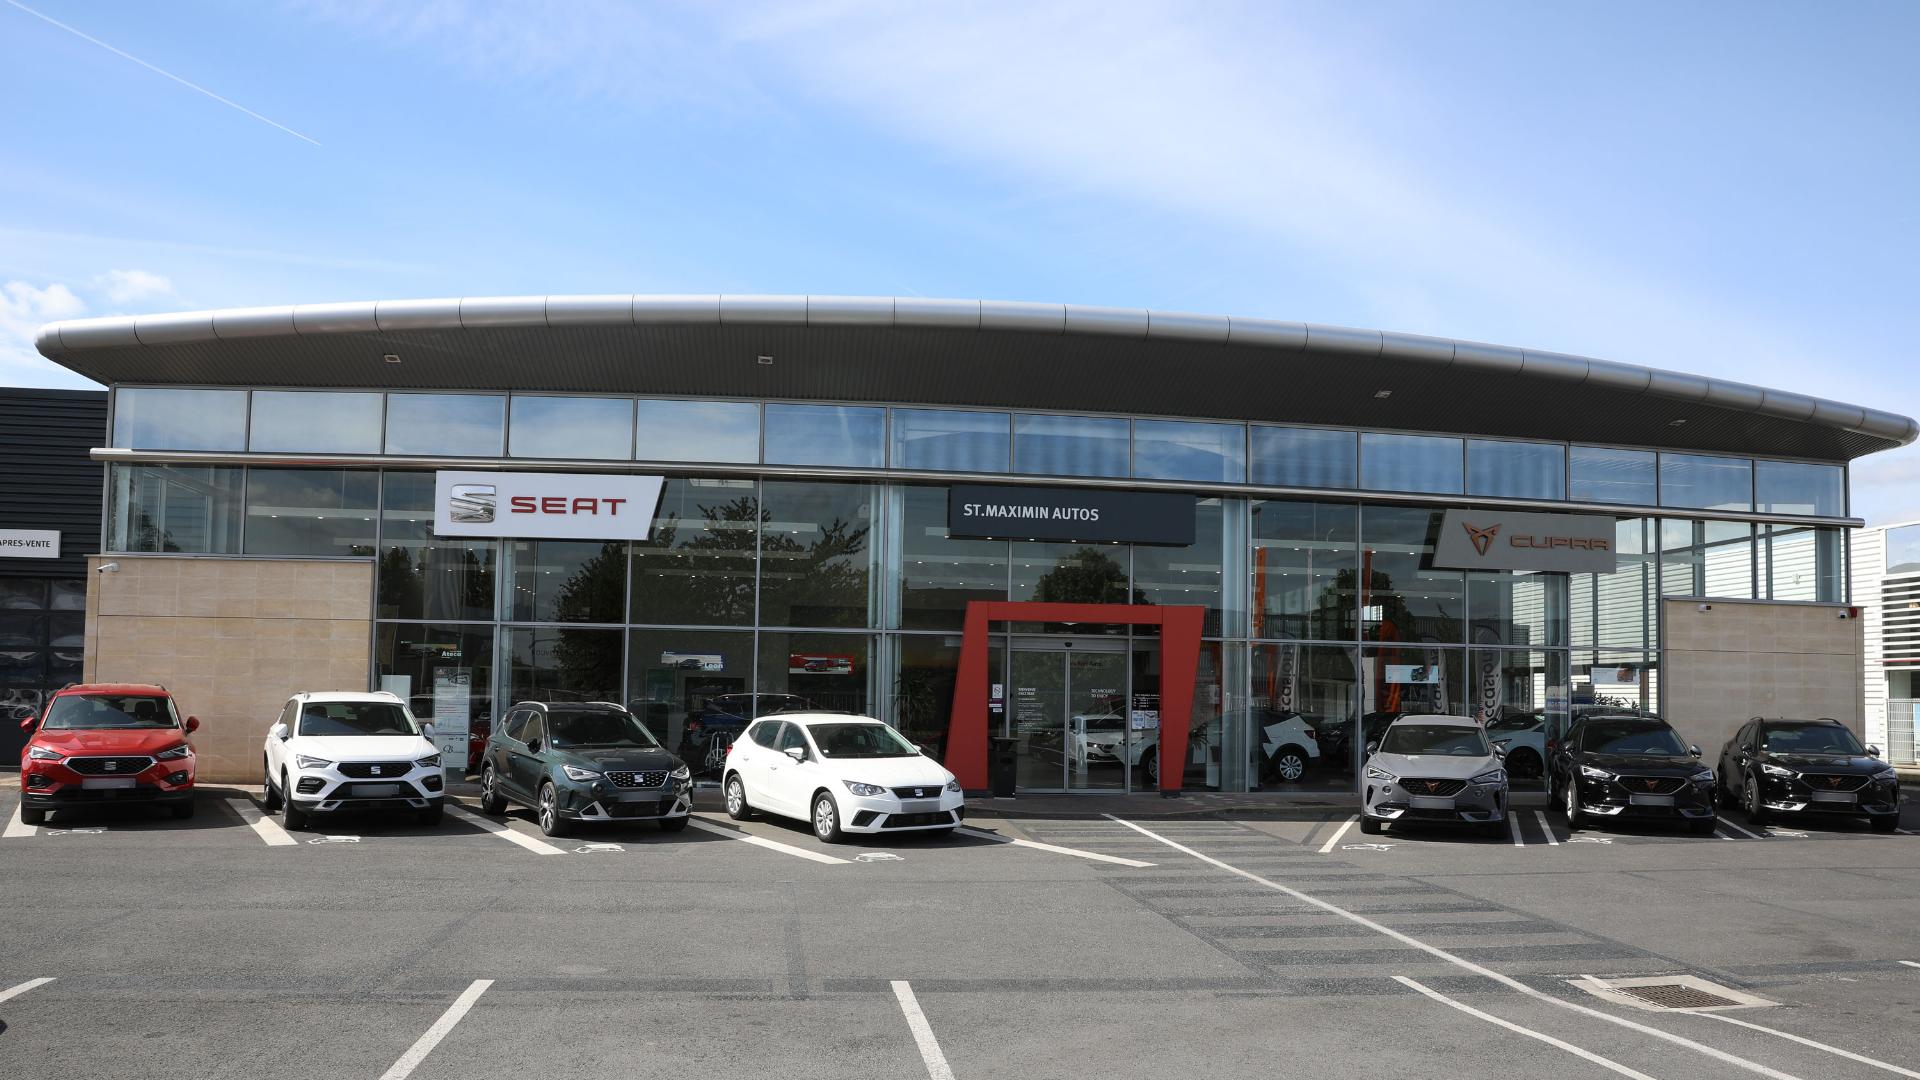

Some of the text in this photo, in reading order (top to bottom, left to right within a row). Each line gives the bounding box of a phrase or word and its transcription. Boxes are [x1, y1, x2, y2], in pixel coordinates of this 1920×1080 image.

[511, 496, 627, 516] SEAT
[963, 503, 1099, 521] ST.MAXIMIN AUTOS
[1510, 535, 1609, 551] CUPRA
